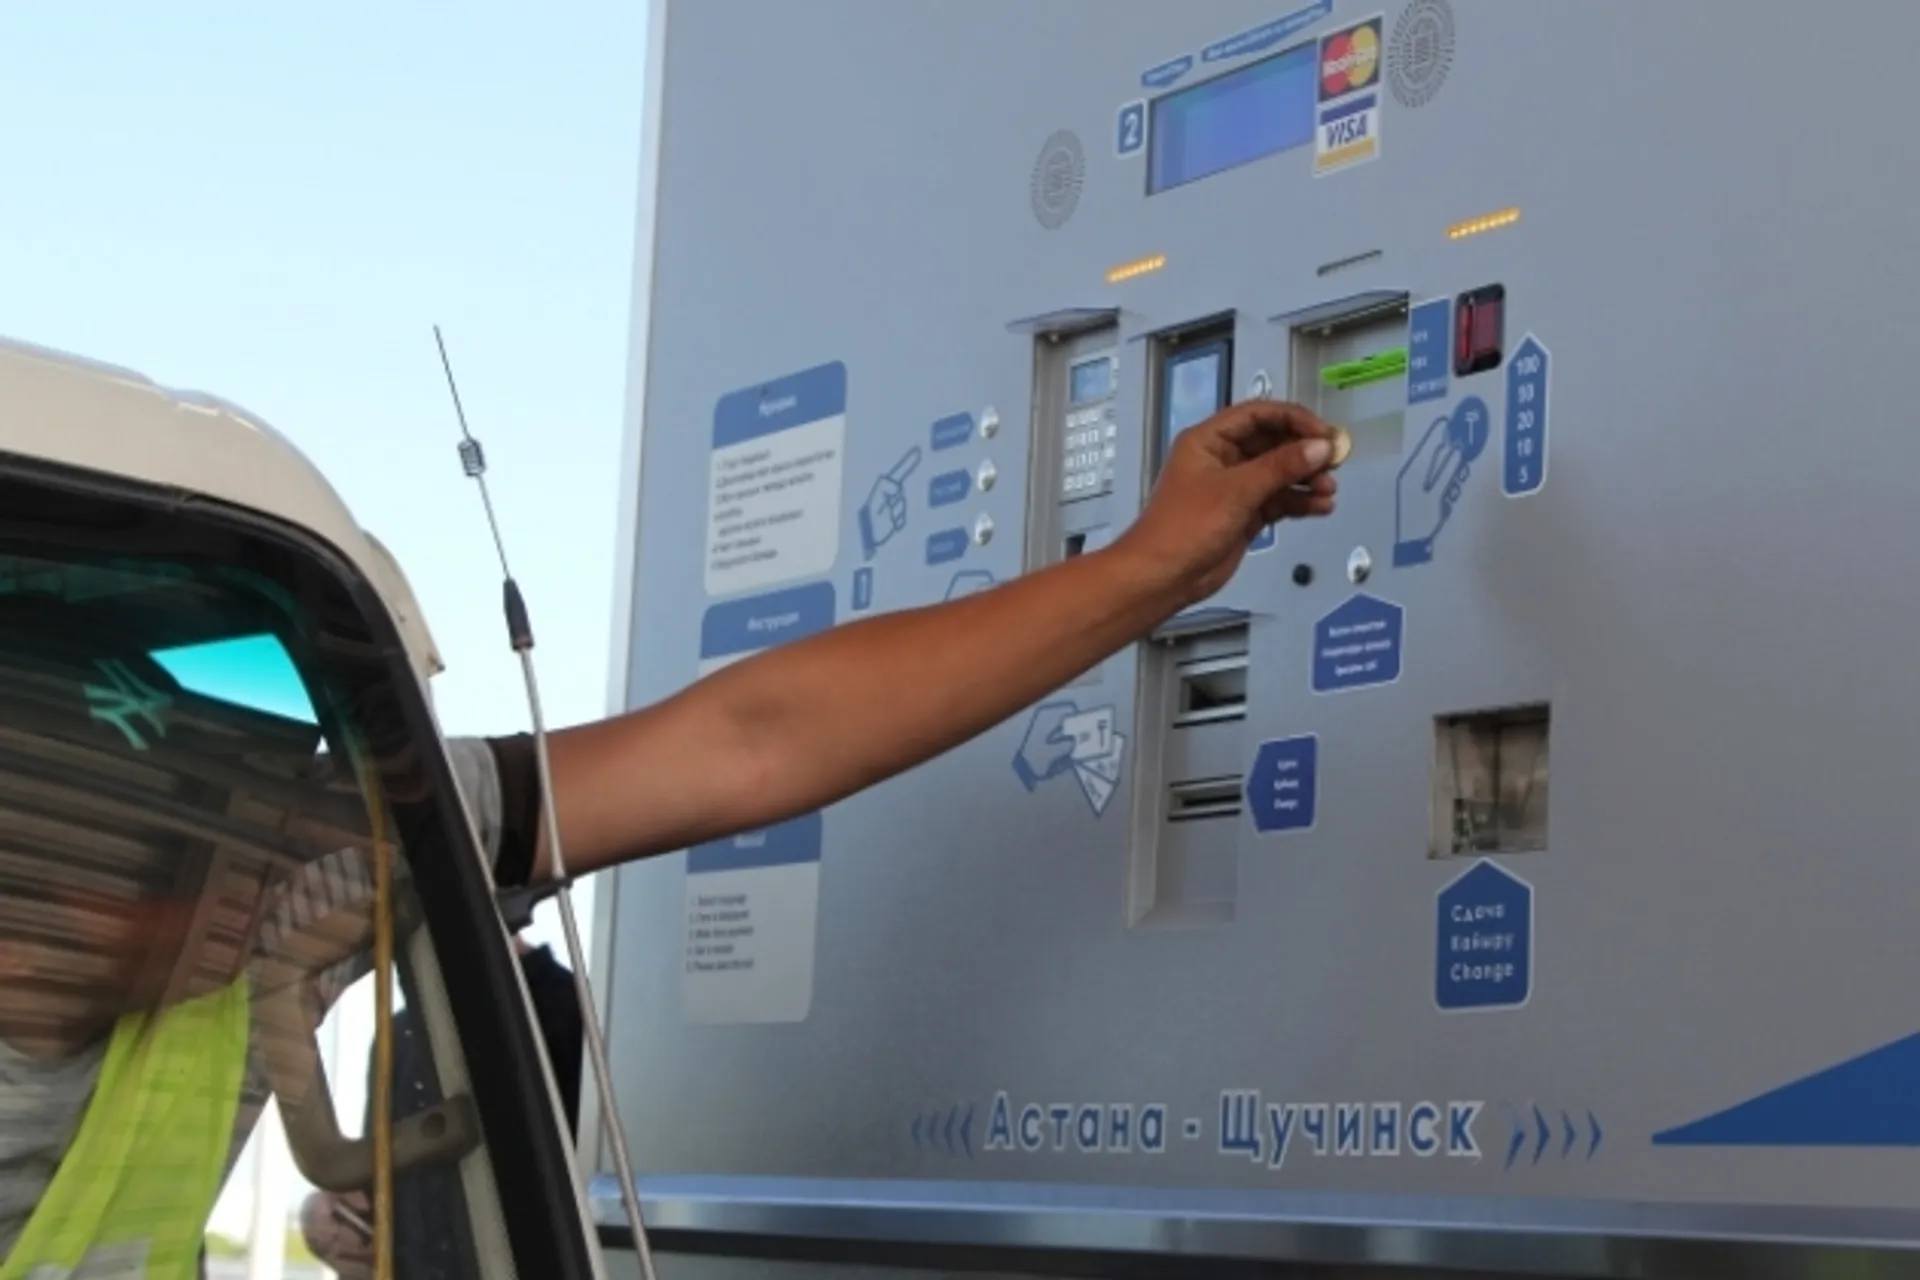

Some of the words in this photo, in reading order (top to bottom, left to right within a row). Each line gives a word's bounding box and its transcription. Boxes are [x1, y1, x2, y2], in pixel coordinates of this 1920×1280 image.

[1124, 112, 1139, 147] 2
[1326, 113, 1367, 148] VISA
[1517, 438, 1532, 457] 10
[1450, 962, 1515, 983] Change
[984, 1089, 1166, 1154] Астана
[1218, 1088, 1485, 1169] Щучинск
